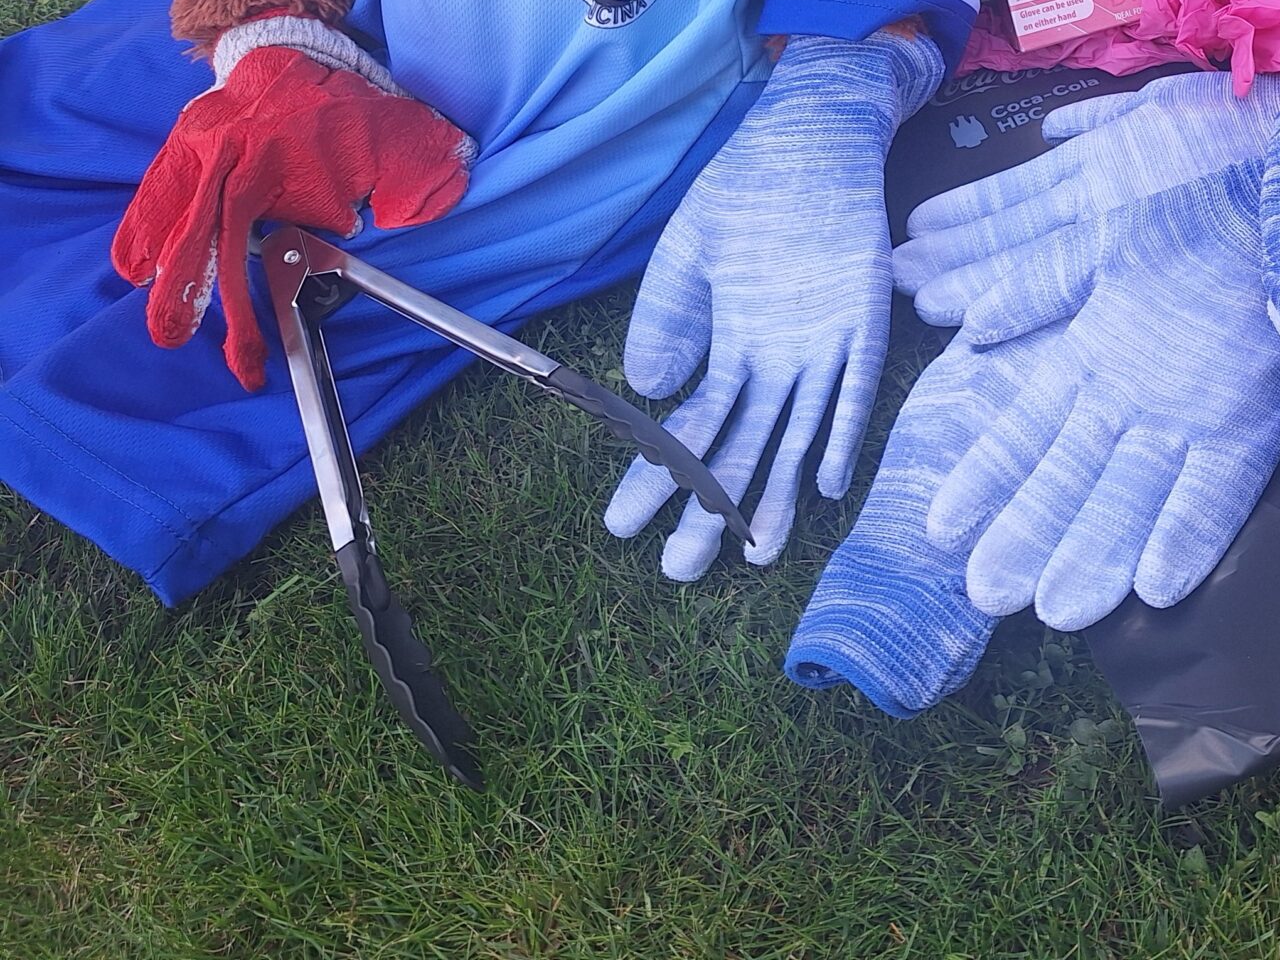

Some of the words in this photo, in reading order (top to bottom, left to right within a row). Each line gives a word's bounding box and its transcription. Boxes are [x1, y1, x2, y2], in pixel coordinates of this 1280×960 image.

[1019, 7, 1041, 19] Glove
[1041, 4, 1055, 14] can
[1055, 0, 1066, 11] be
[1023, 23, 1034, 32] on
[1034, 15, 1057, 29] either
[1057, 10, 1077, 24] hand
[990, 78, 1100, 119] Coca-Cola
[996, 107, 1046, 134] HBC
